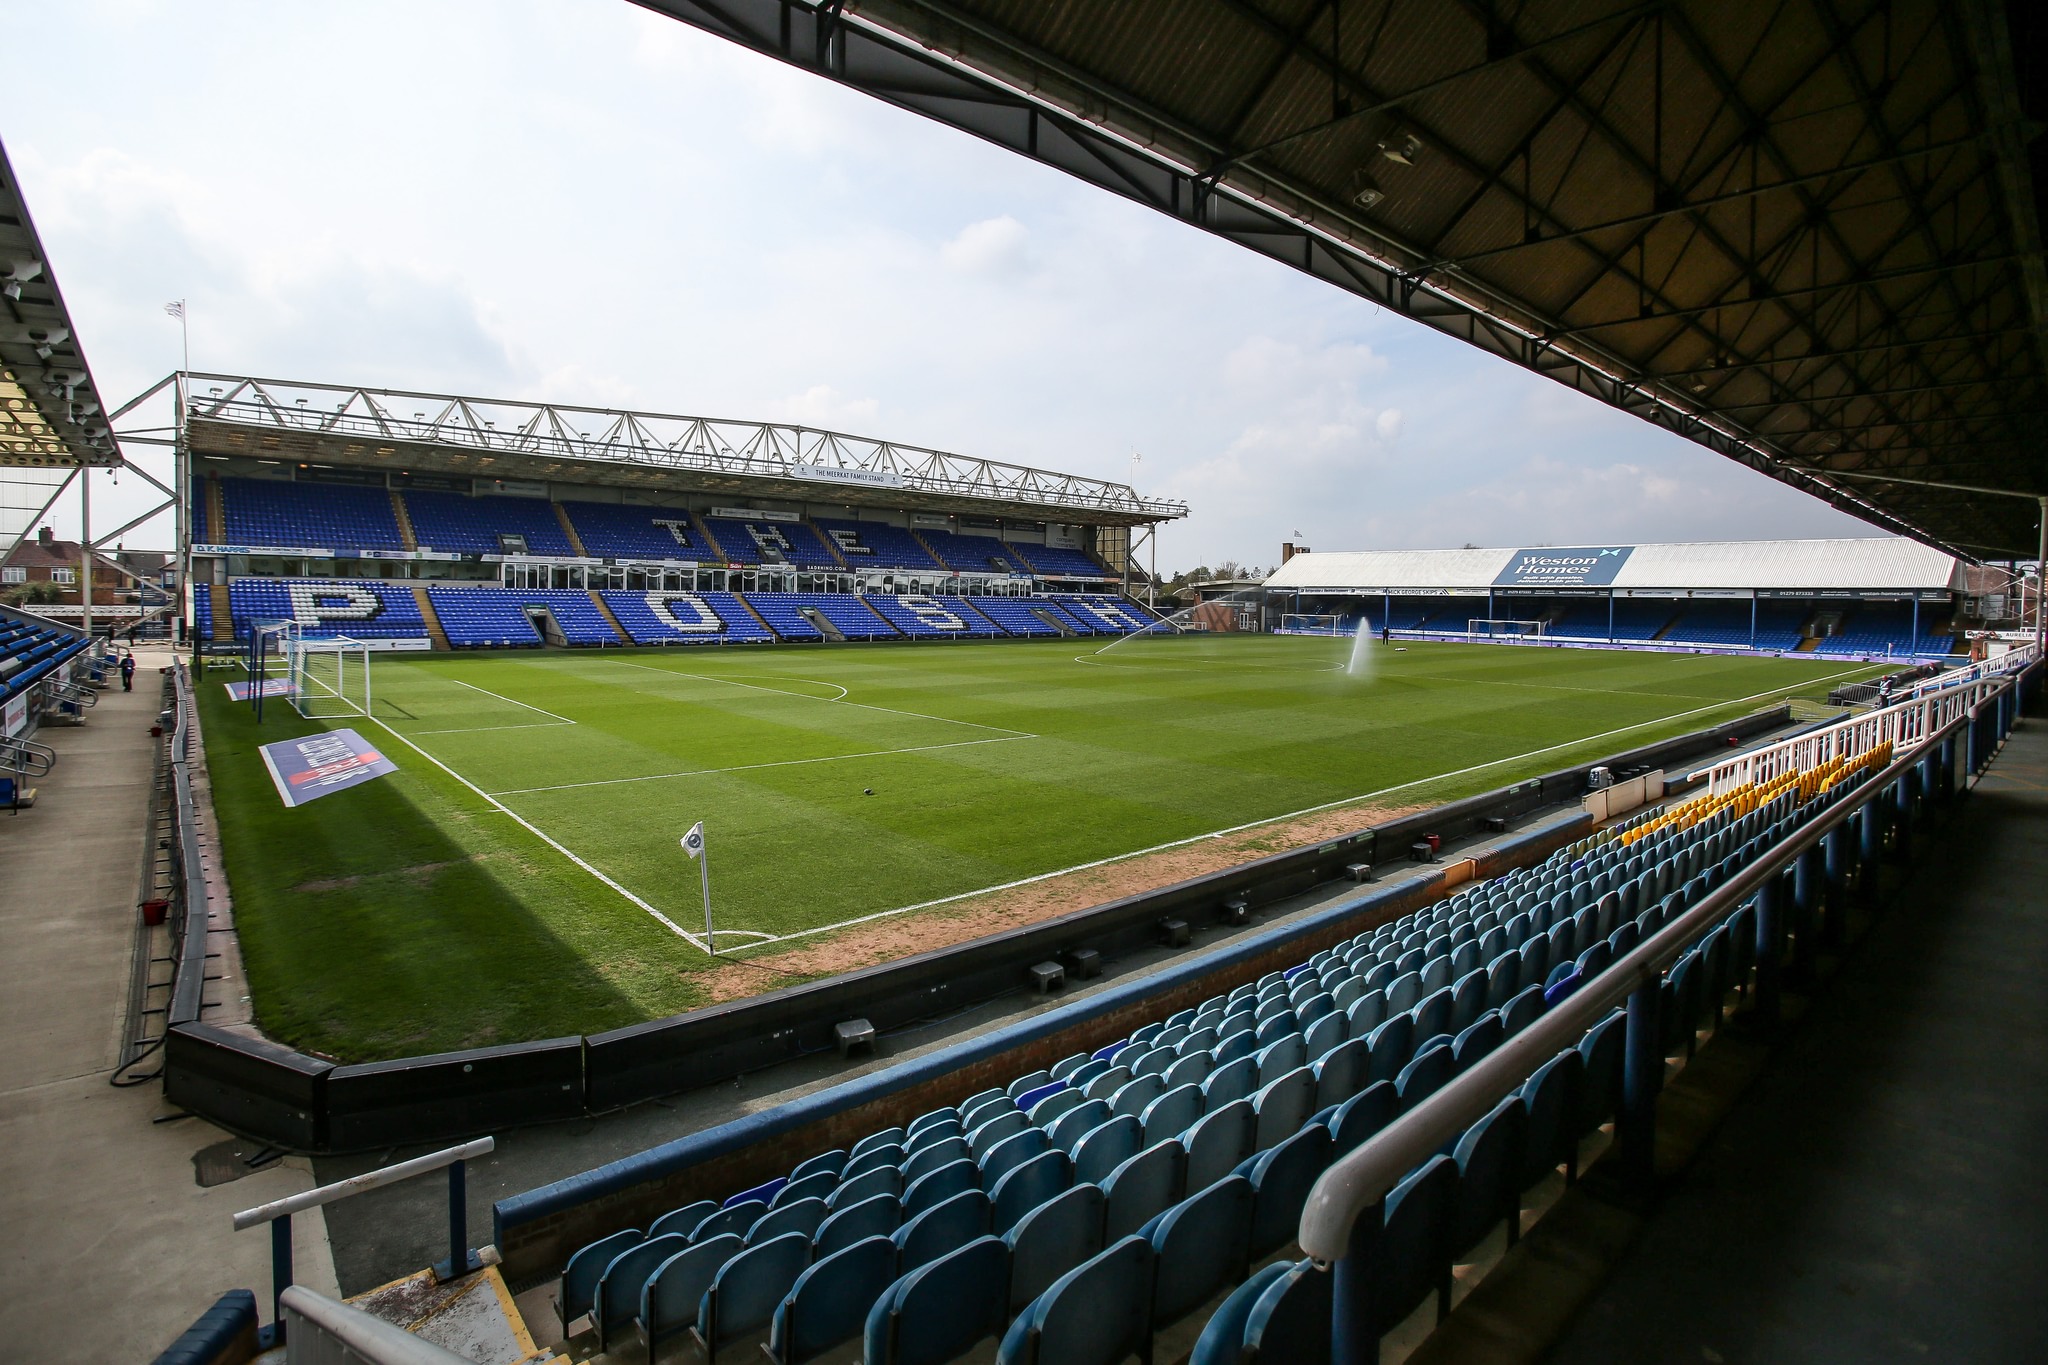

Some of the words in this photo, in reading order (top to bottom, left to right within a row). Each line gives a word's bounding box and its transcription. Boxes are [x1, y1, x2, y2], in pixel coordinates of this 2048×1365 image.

[815, 469, 826, 477] THE
[826, 470, 850, 479] MEERKAT
[850, 472, 868, 481] FAMILY
[868, 475, 885, 483] STAND
[1523, 556, 1598, 566] Weston
[1514, 565, 1591, 574] Homes
